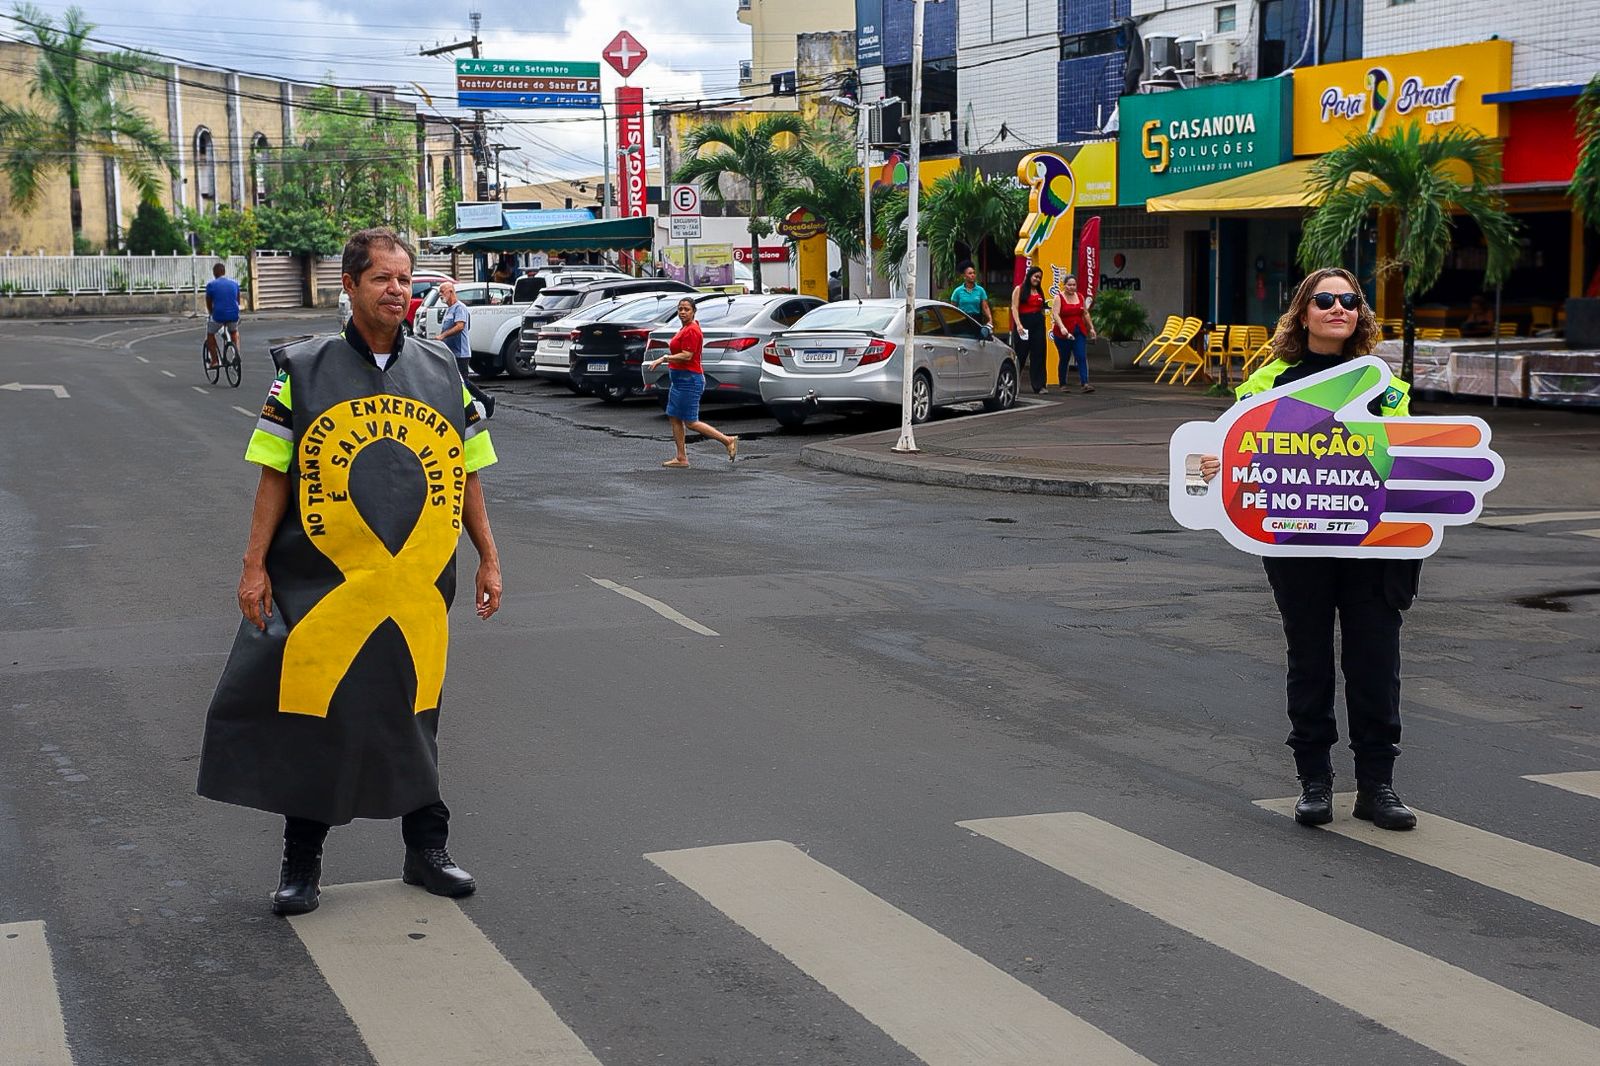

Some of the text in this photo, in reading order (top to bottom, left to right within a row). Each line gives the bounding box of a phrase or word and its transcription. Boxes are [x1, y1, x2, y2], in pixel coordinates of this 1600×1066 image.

[473, 64, 488, 72] Av.
[509, 65, 520, 73] de
[525, 65, 569, 74] Setembro
[461, 80, 575, 90] Teatro/Cidade do Saber
[1397, 78, 1457, 113] Brasil
[1170, 113, 1255, 140] CASANOVA
[1170, 141, 1253, 158] SOLUÇÕES
[1236, 160, 1253, 169] VIDA
[680, 191, 690, 206] E
[1086, 246, 1095, 296] Prepara
[1100, 274, 1141, 291] Prepara
[1238, 427, 1375, 460] ATENÇÃO!
[300, 398, 463, 537] NO TRÂNSITO ENXERGAR O OUTRO
[326, 420, 446, 507] É SALVAR VIDAS
[1232, 463, 1380, 490] MÃO NA FAIXA,
[1242, 489, 1369, 512] PÉ NO FREIO.
[1272, 522, 1317, 531] CAMAÇARI
